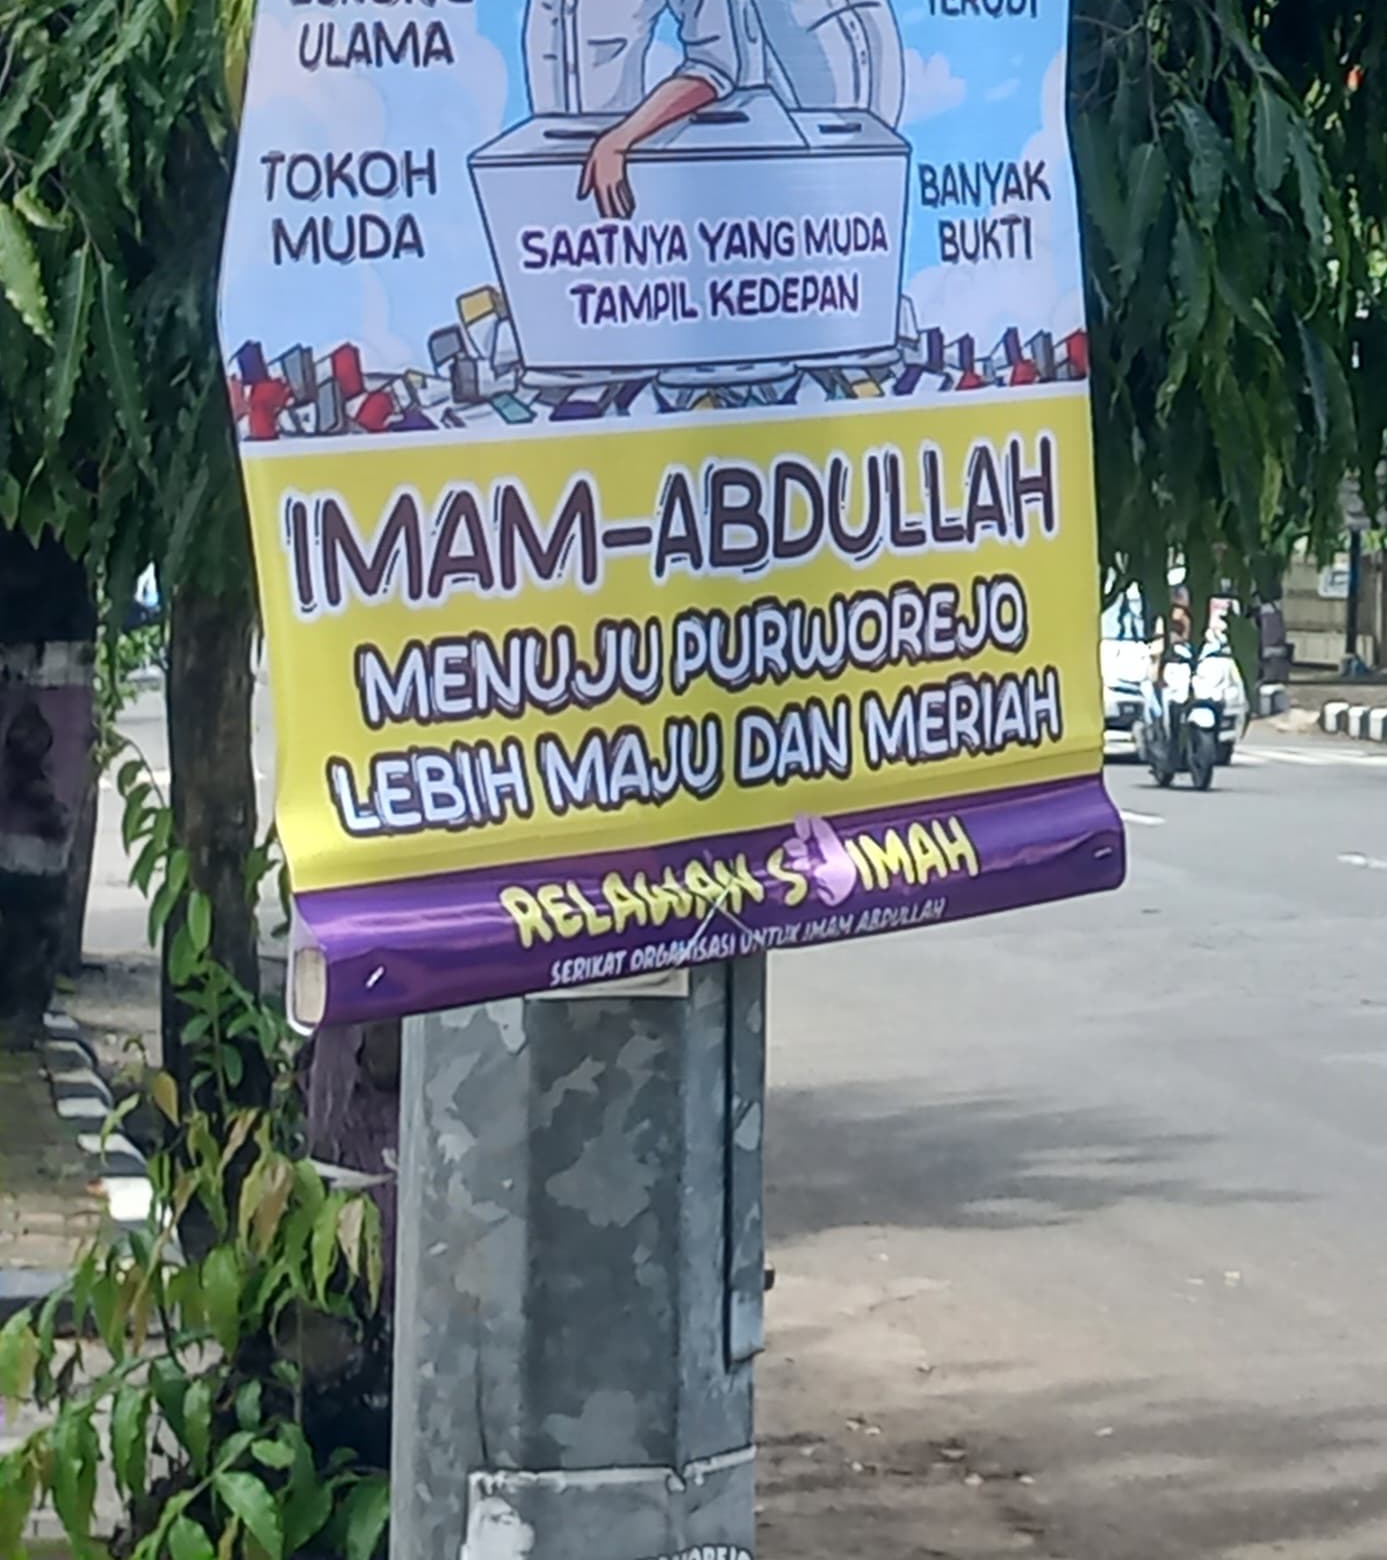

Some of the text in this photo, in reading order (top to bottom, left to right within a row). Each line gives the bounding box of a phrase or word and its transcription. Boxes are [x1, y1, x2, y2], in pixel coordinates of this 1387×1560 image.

[299, 20, 455, 70] ULAMA
[261, 149, 438, 203] TOKOH
[920, 160, 1051, 207] BANYAK
[272, 215, 425, 265] MUDA
[520, 215, 889, 269] SAATNYA YANG MUDA
[938, 218, 1033, 265] BUKTI
[569, 271, 859, 325] TAMPIL KEDEPAN
[357, 574, 1027, 728] MENUJU PURWOREJO
[328, 666, 1062, 837] LEBIH MAJU DAN MERIAH
[500, 854, 763, 951] RELAWAN
[550, 897, 947, 987] SERIKAT ORGANISASI UNTUK IMAM ABDULLAH
